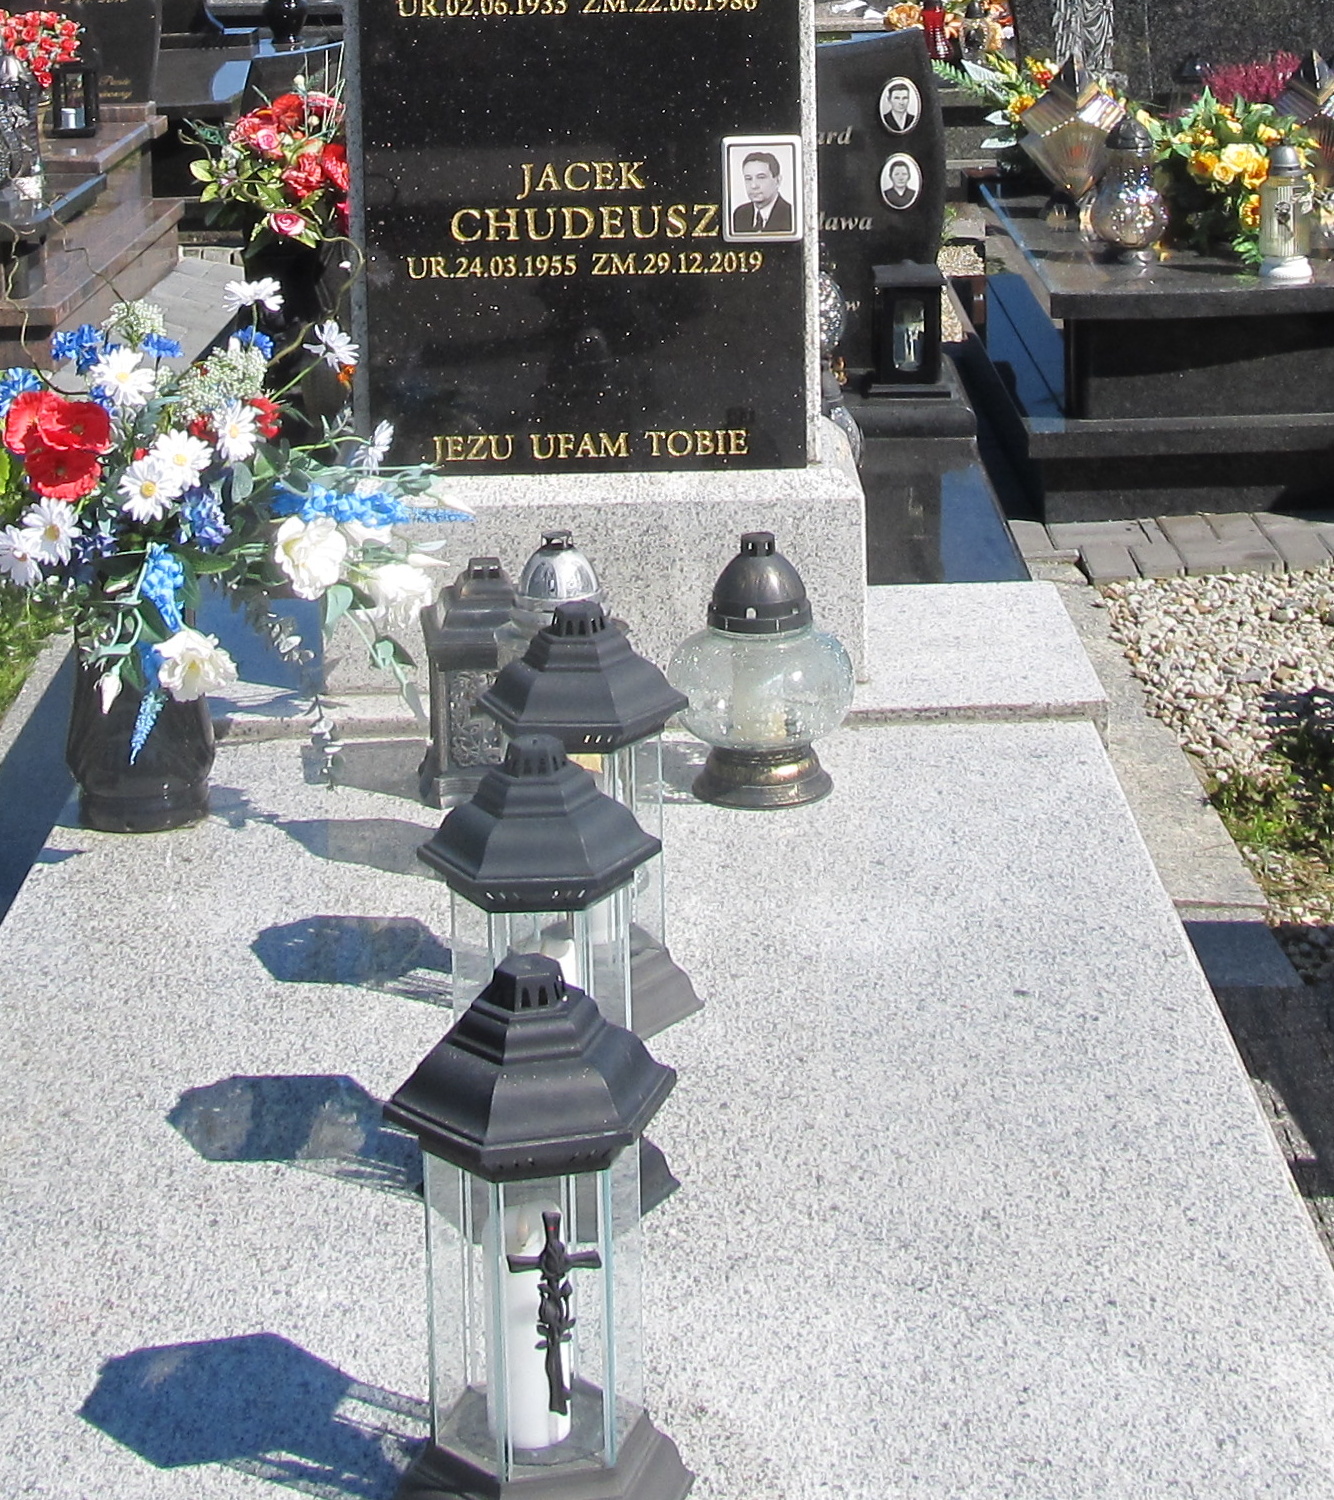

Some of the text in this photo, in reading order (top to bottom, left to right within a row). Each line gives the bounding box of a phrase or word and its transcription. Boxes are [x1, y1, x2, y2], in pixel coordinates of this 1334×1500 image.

[517, 161, 646, 200] JACEK
[449, 203, 719, 242] CHUDEUSZ
[406, 250, 764, 279] UR.24.03.1955 ZM.29.12.2019
[431, 429, 750, 463] JEZU UFAM TOBIE
